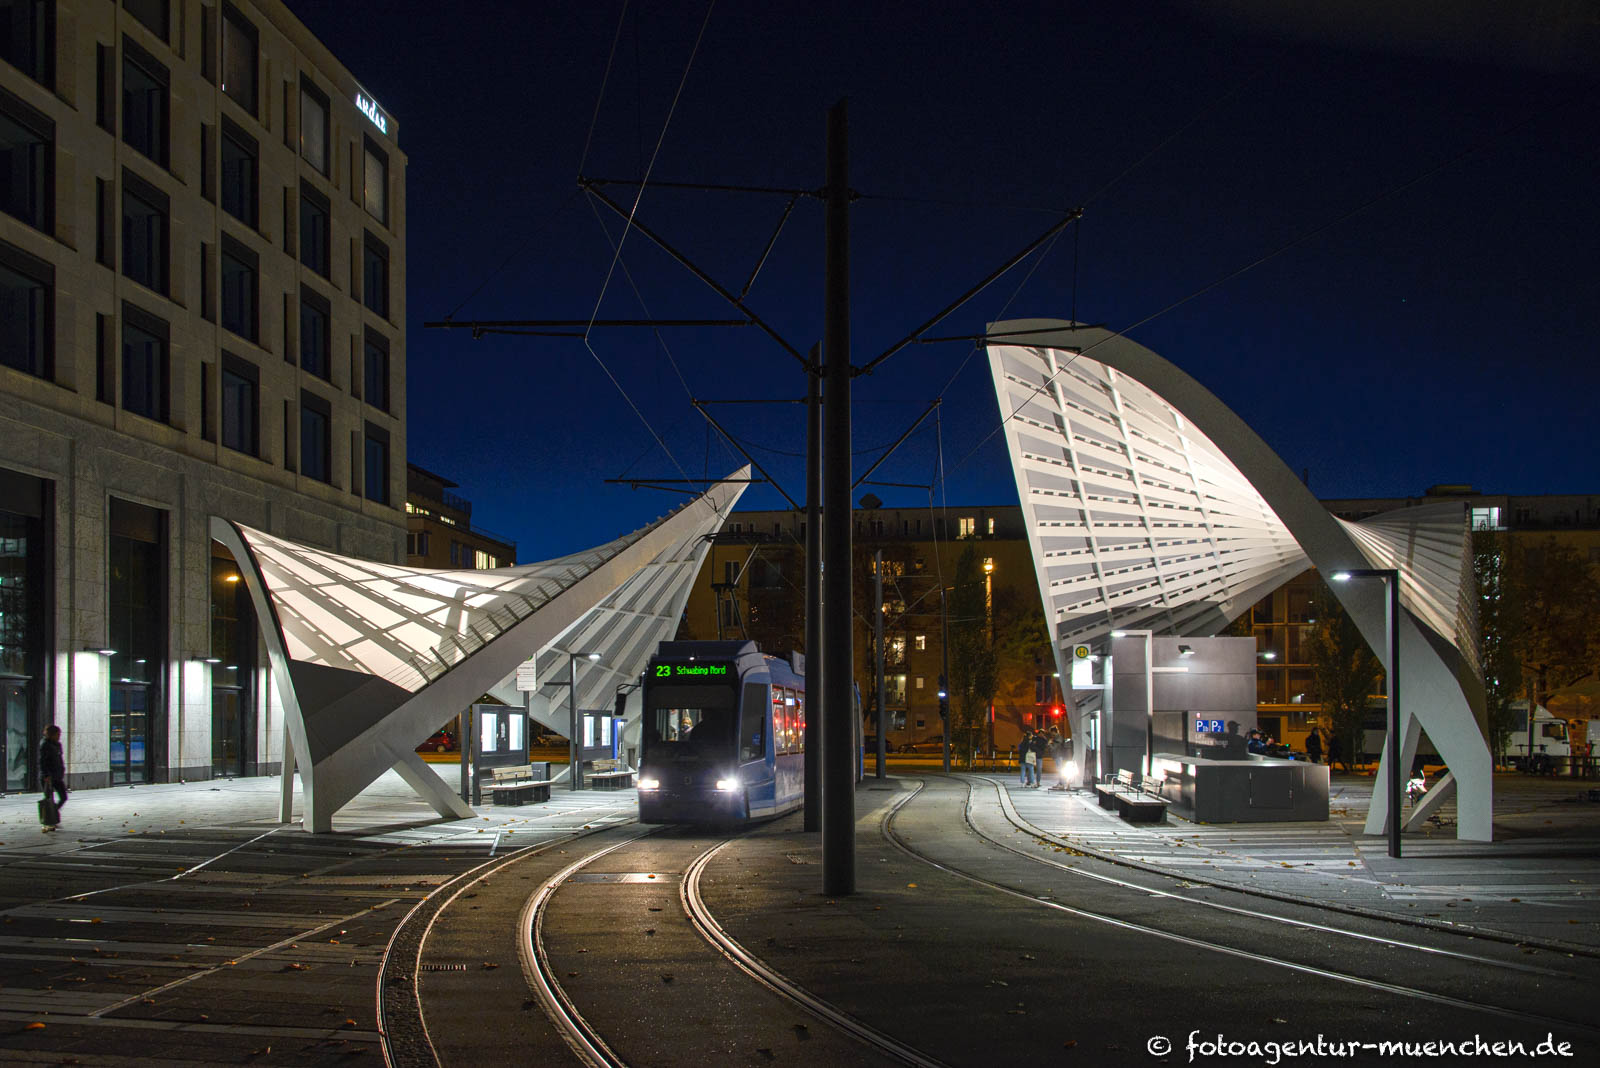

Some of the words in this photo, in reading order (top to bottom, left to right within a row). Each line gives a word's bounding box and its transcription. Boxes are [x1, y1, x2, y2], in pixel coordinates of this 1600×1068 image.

[656, 665, 671, 677] 23
[676, 665, 709, 676] Schwabing
[710, 665, 727, 675] Nord
